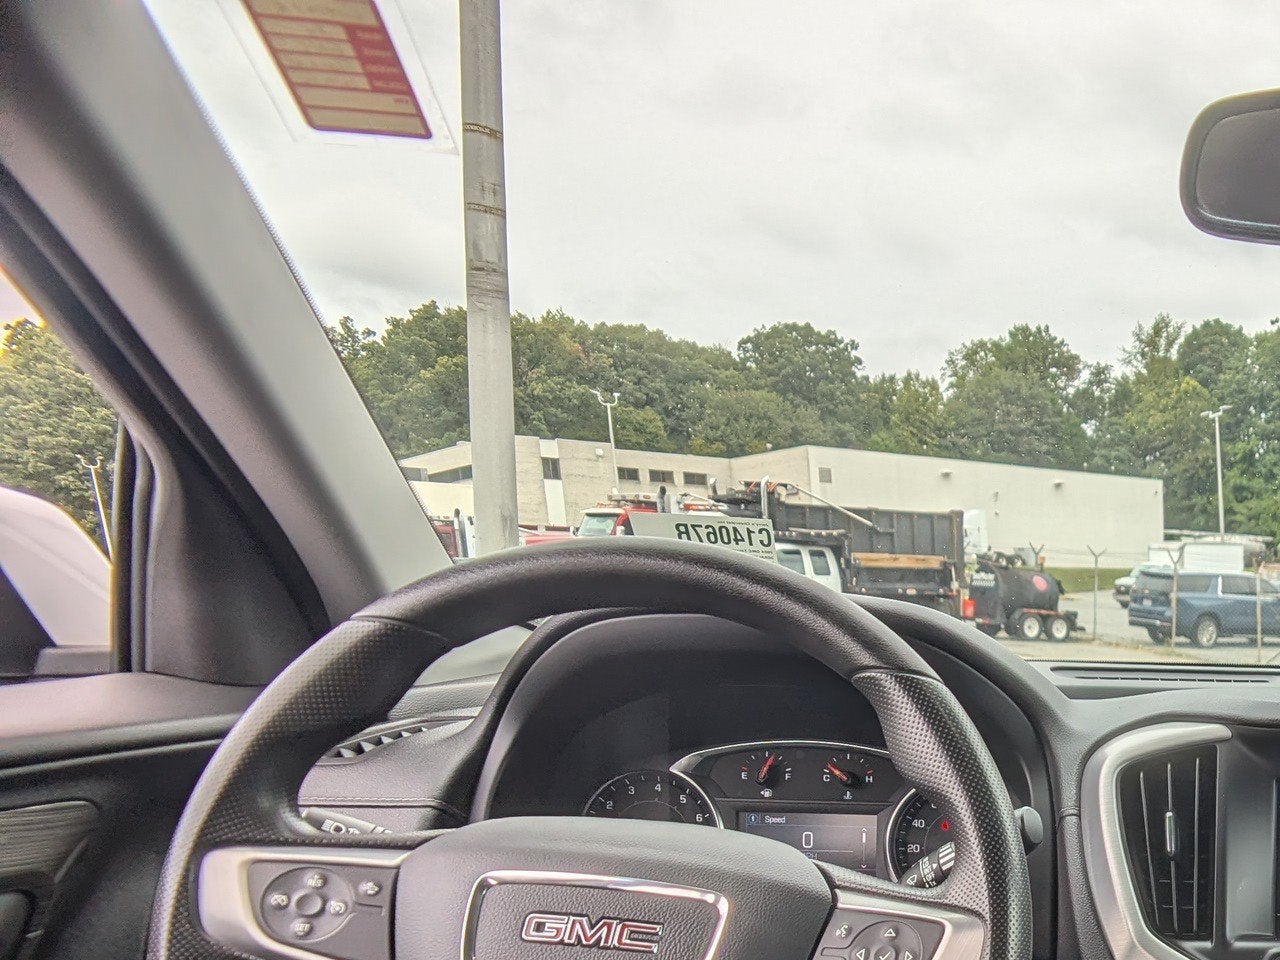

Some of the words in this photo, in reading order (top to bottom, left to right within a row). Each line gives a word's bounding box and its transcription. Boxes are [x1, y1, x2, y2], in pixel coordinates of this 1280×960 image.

[741, 771, 748, 780] E
[785, 773, 792, 781] F
[823, 774, 831, 782] C
[865, 775, 873, 783] H
[628, 785, 635, 795] 3
[654, 783, 662, 792] 4
[680, 794, 687, 804] 5
[606, 800, 613, 810] 2
[695, 813, 703, 822] 6
[764, 815, 786, 824] Speed
[911, 819, 925, 828] 40
[802, 831, 814, 849] 0
[907, 844, 920, 853] 20
[521, 912, 663, 954] GMC
